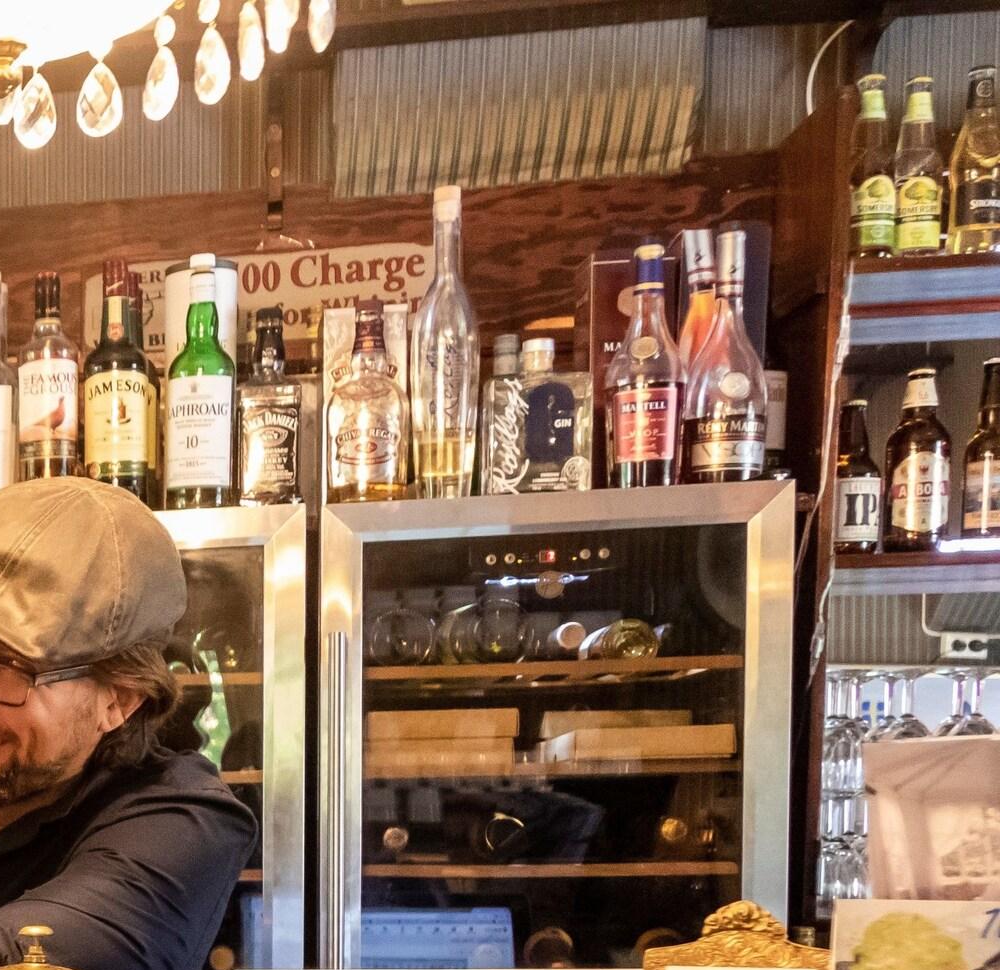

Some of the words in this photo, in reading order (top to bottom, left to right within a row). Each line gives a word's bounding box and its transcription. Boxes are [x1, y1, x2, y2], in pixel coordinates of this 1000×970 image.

[290, 252, 426, 293] Charge
[88, 379, 146, 401] JAMESON
[554, 418, 572, 429] GIN
[186, 435, 199, 449] 10
[843, 493, 878, 526] IP
